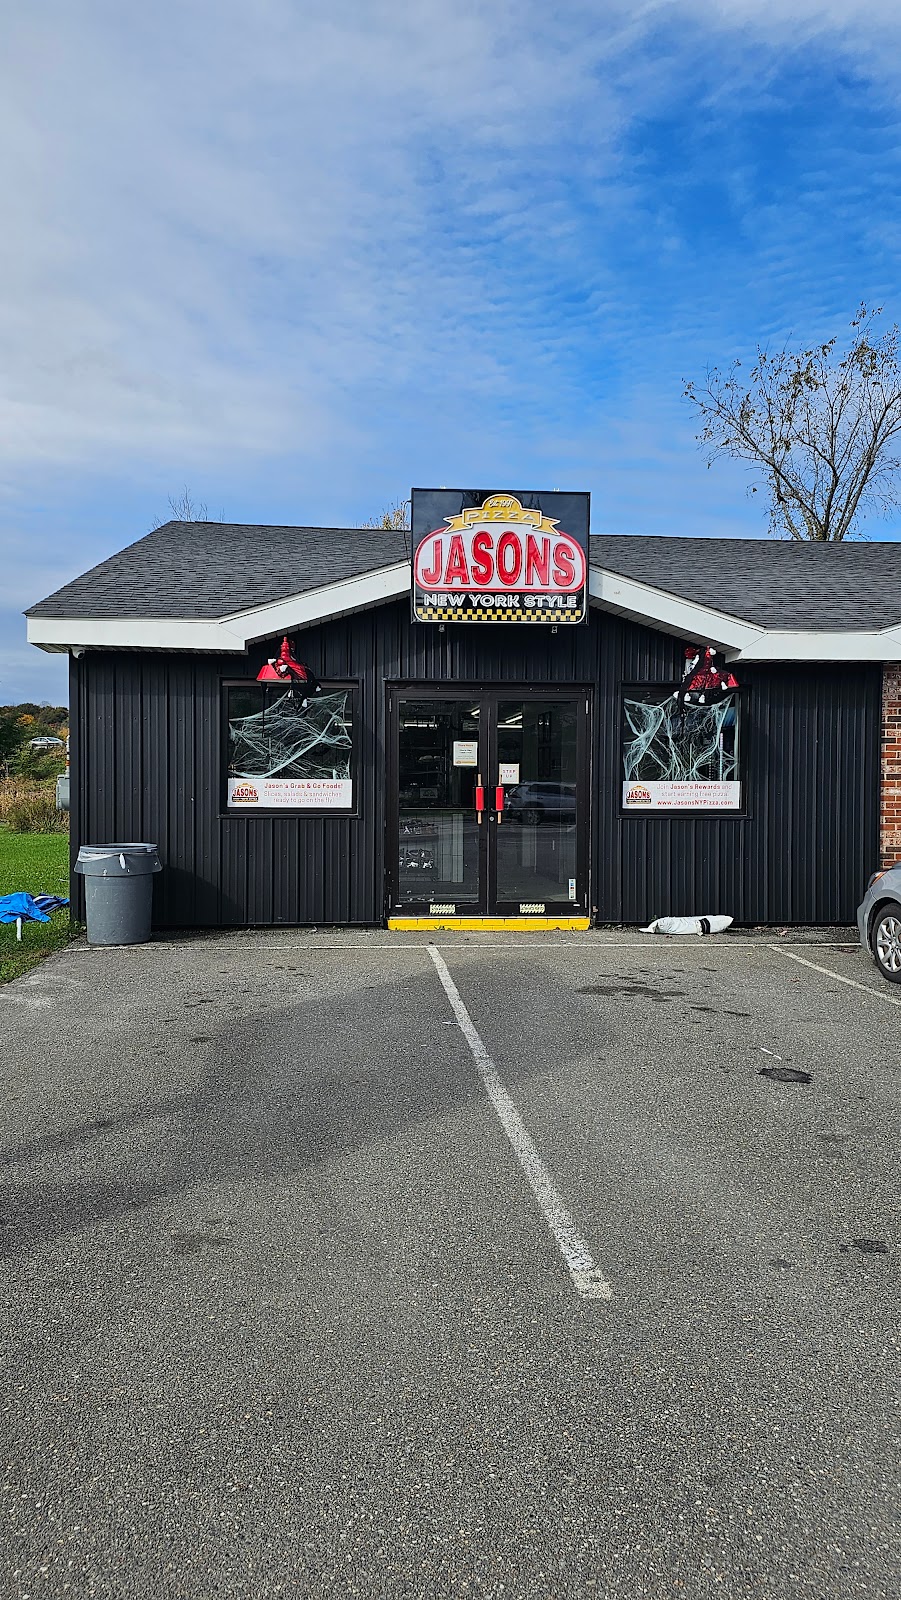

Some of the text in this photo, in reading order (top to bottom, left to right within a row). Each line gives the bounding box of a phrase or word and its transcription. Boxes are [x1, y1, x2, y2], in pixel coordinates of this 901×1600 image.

[500, 499, 514, 509] 1997
[466, 510, 536, 521] PIZZA
[421, 530, 575, 586] JASONS
[423, 593, 577, 608] NEW YORK STYLE
[231, 788, 258, 797] JASONS
[626, 790, 651, 798] JASONS
